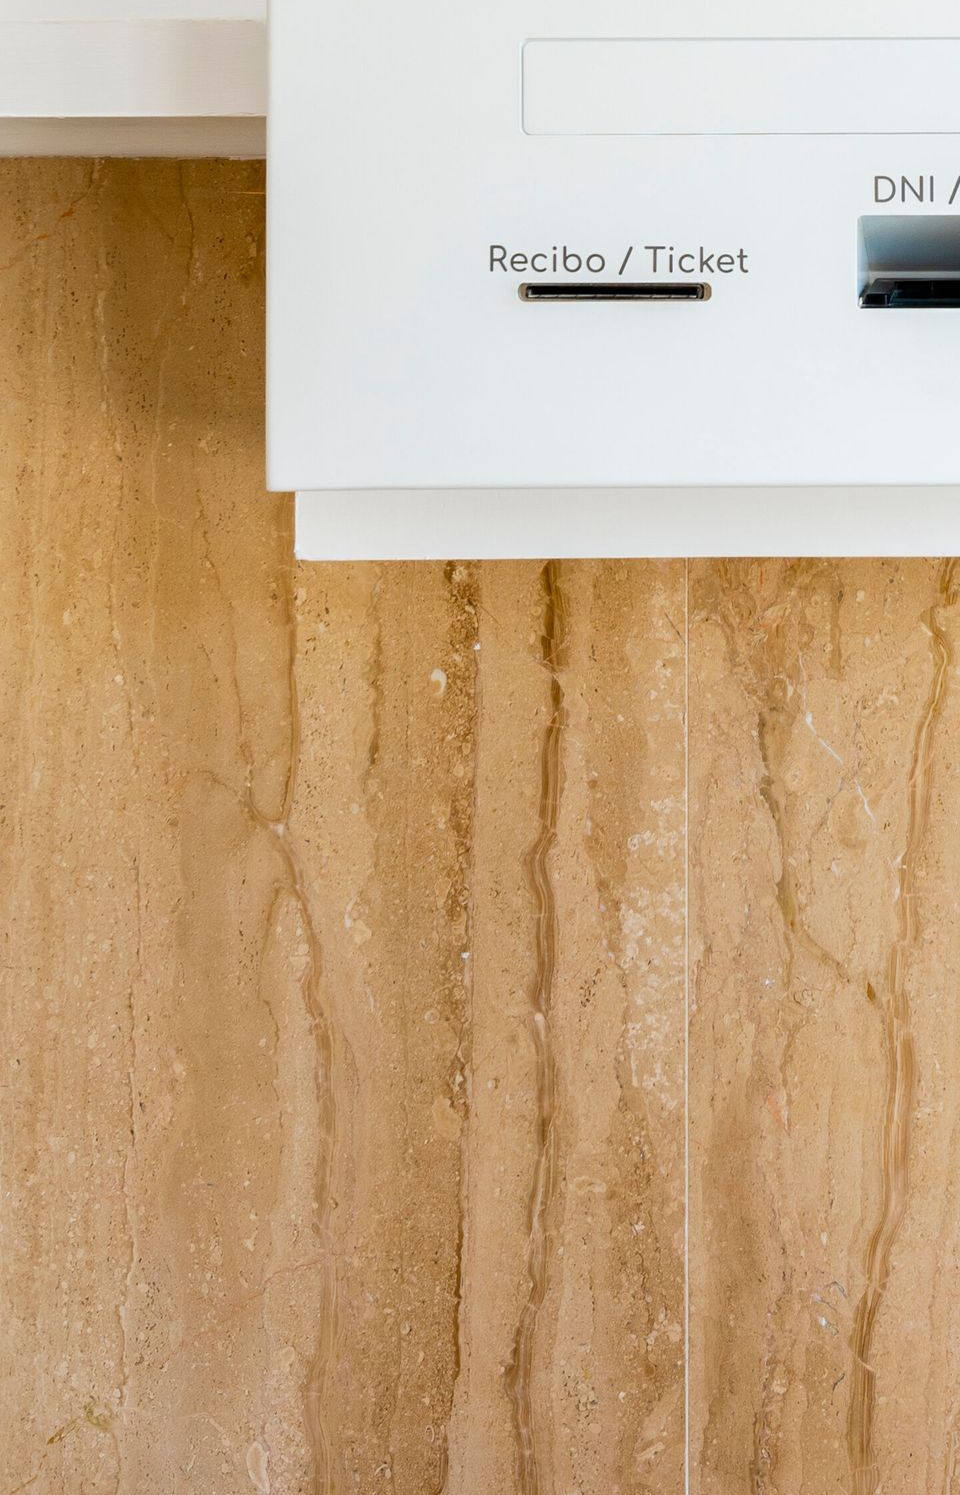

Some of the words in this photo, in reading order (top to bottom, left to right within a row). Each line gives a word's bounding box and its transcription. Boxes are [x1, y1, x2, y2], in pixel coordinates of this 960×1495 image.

[874, 175, 934, 203] DNI
[489, 244, 606, 274] Recibo
[618, 245, 634, 276] /
[643, 245, 749, 274] Ticket
